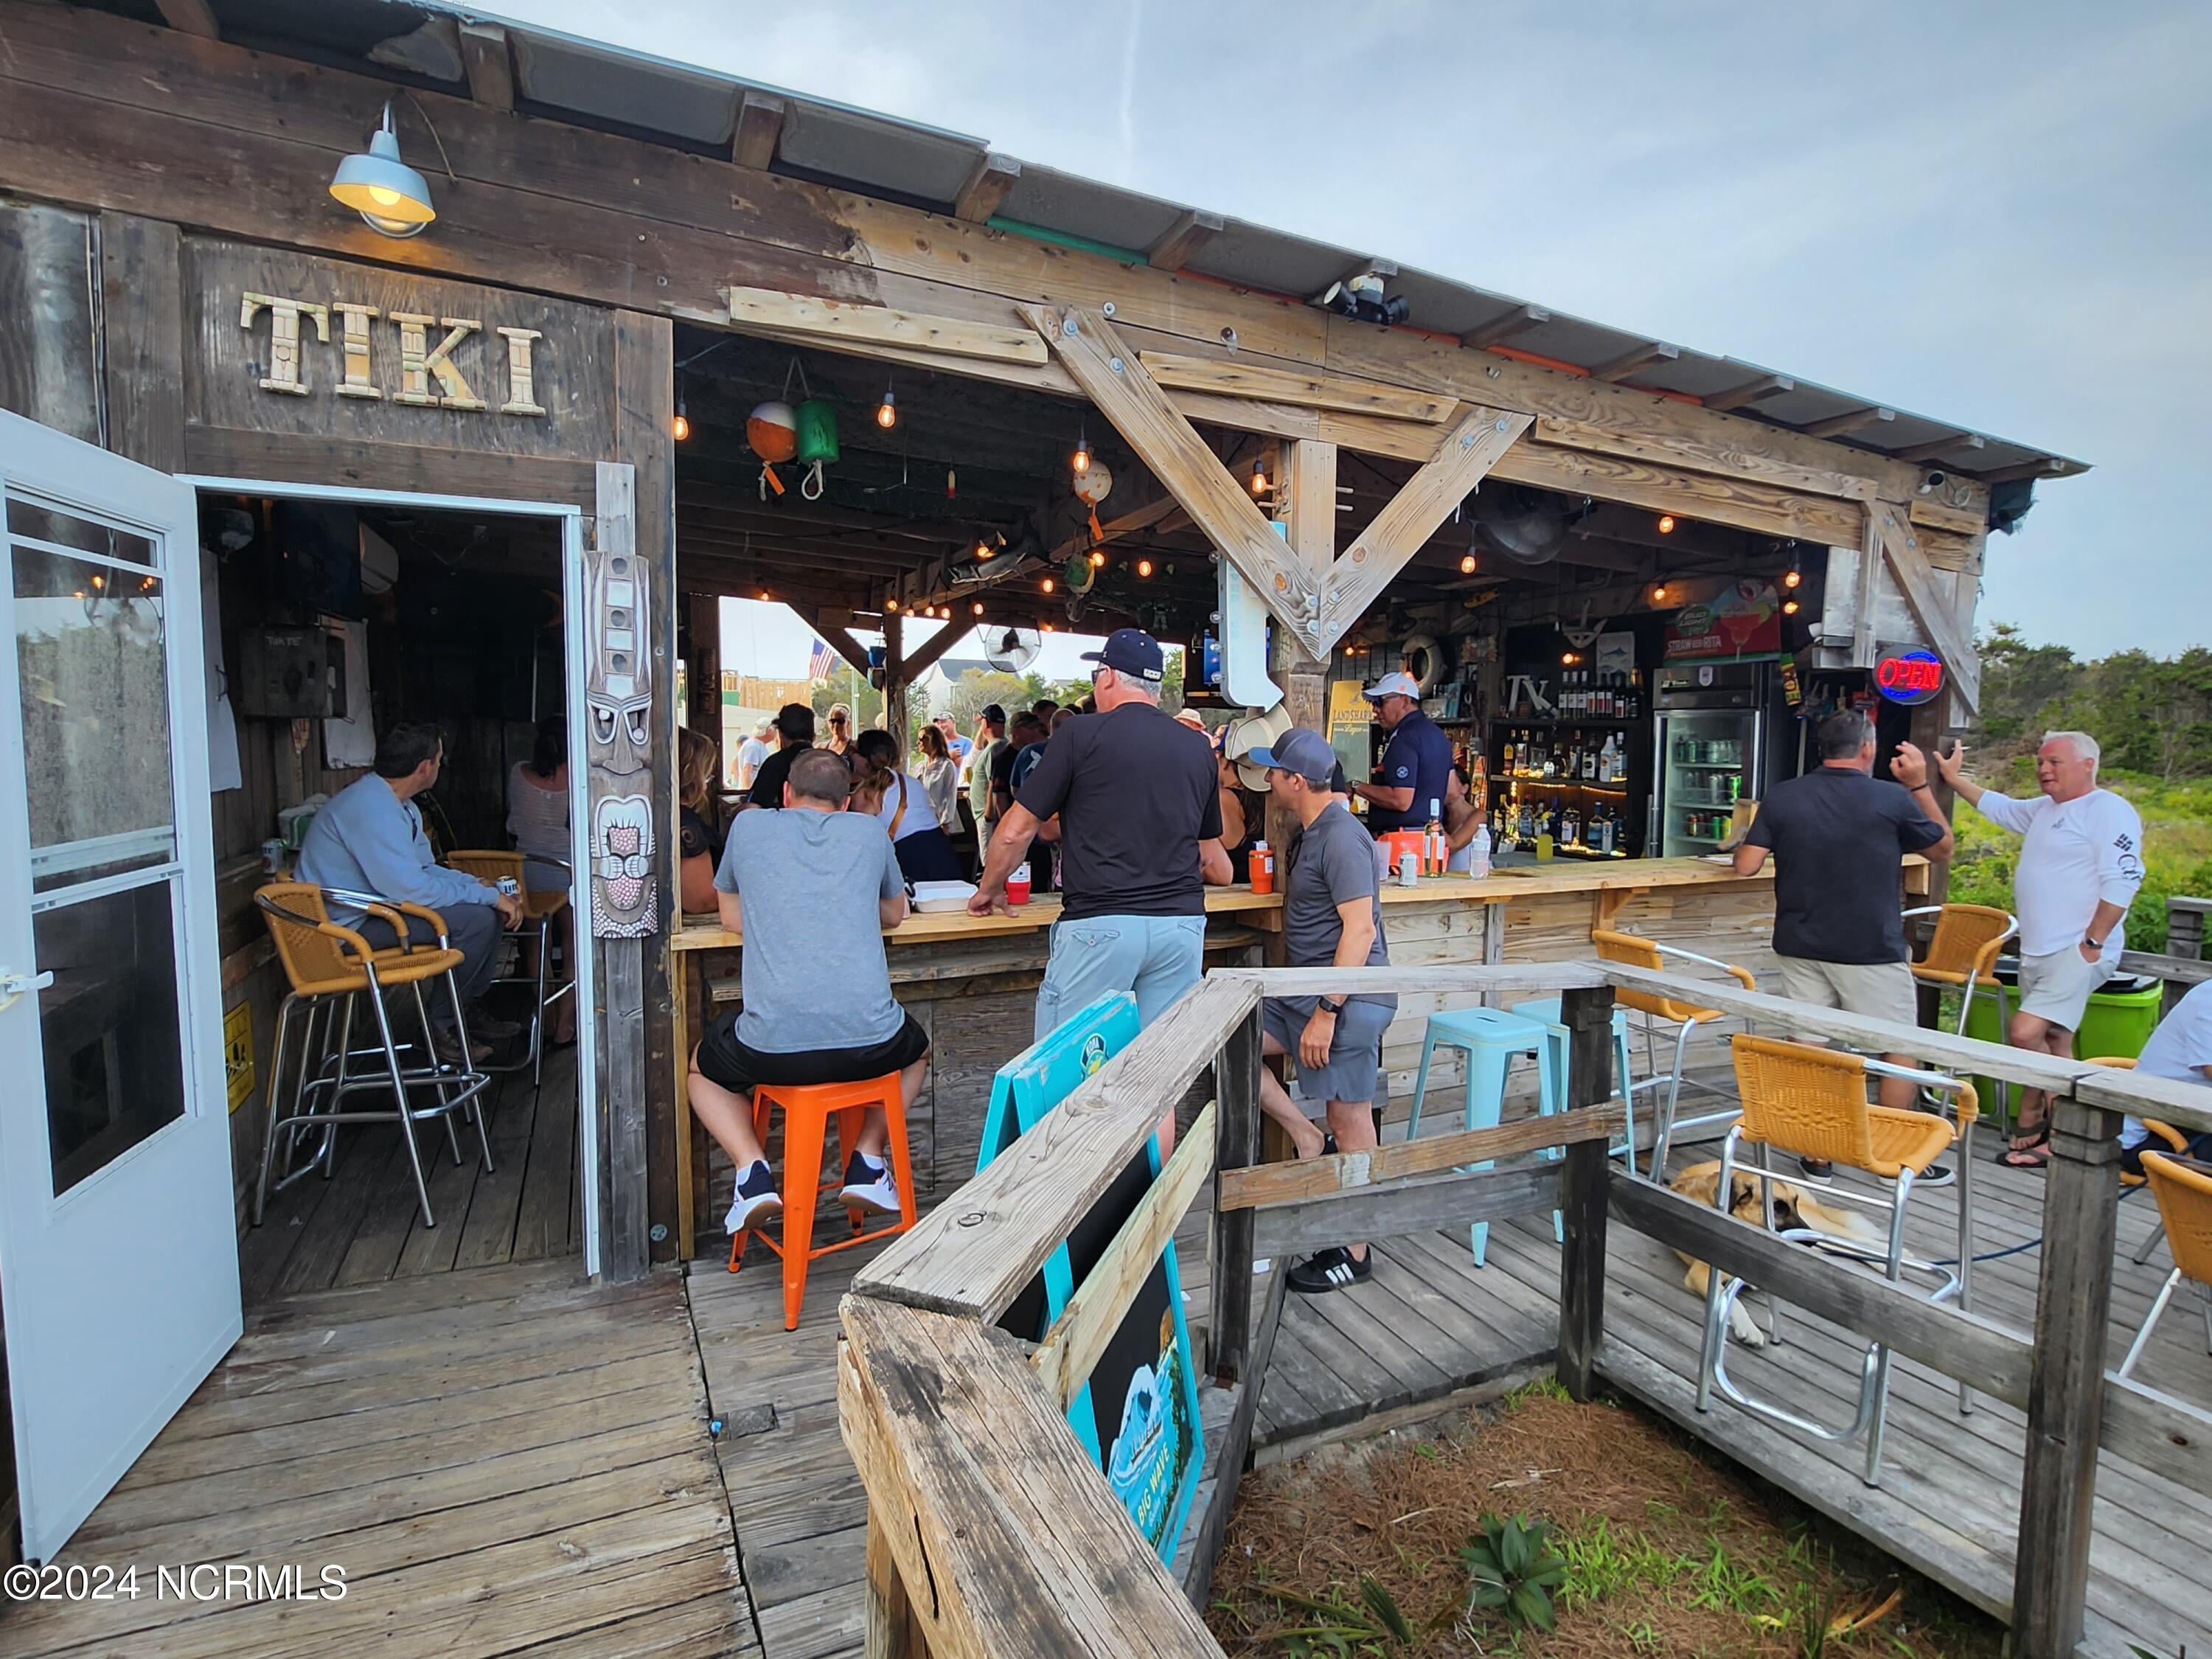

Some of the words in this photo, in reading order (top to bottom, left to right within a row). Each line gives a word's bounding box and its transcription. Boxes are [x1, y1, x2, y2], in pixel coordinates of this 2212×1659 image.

[240, 291, 546, 417] TIKI
[1685, 611, 1707, 619] BUD
[1877, 658, 1941, 689] OPEN
[1138, 1488, 1152, 1528] BIG
[1150, 1441, 1169, 1494] WAVE
